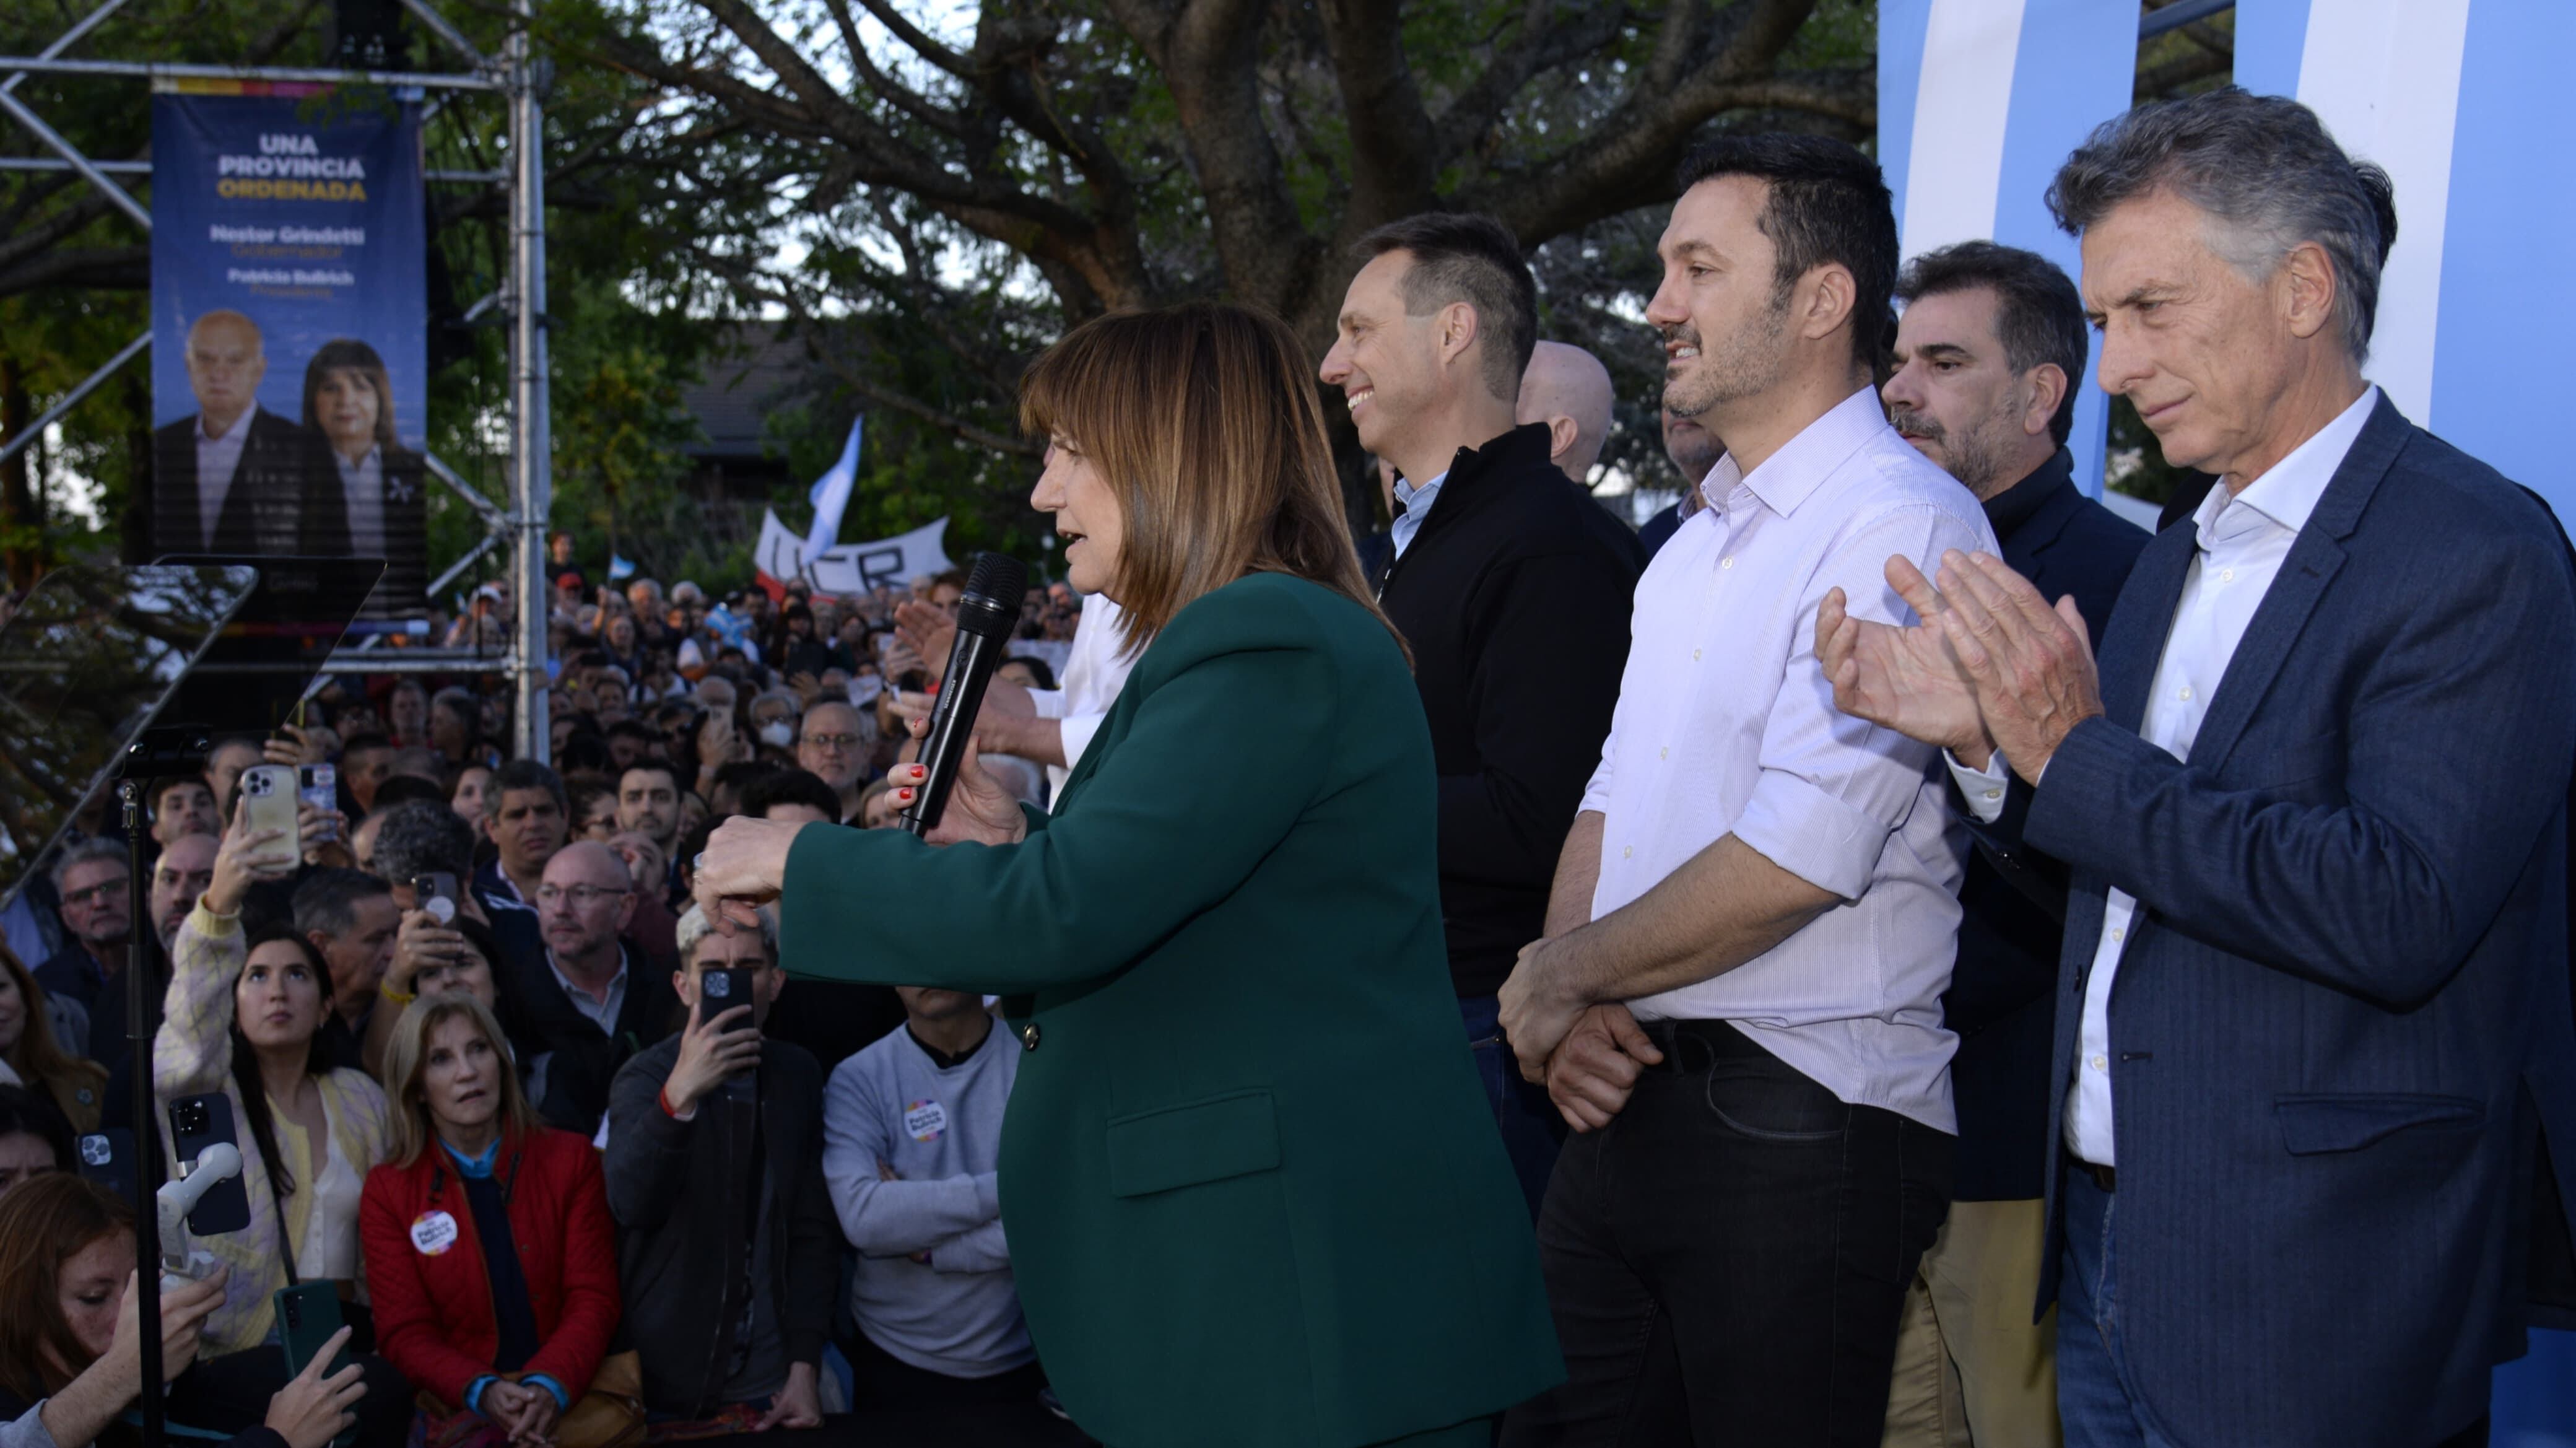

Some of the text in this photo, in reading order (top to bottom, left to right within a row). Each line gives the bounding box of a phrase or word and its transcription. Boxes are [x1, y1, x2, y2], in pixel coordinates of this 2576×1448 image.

[261, 134, 318, 154] UNA
[220, 157, 364, 178] PROVINCIA
[219, 180, 365, 201] ORDENADA
[280, 225, 365, 245] Grindetti
[228, 268, 354, 286] Patricia Bullrich
[772, 534, 912, 595] UCR
